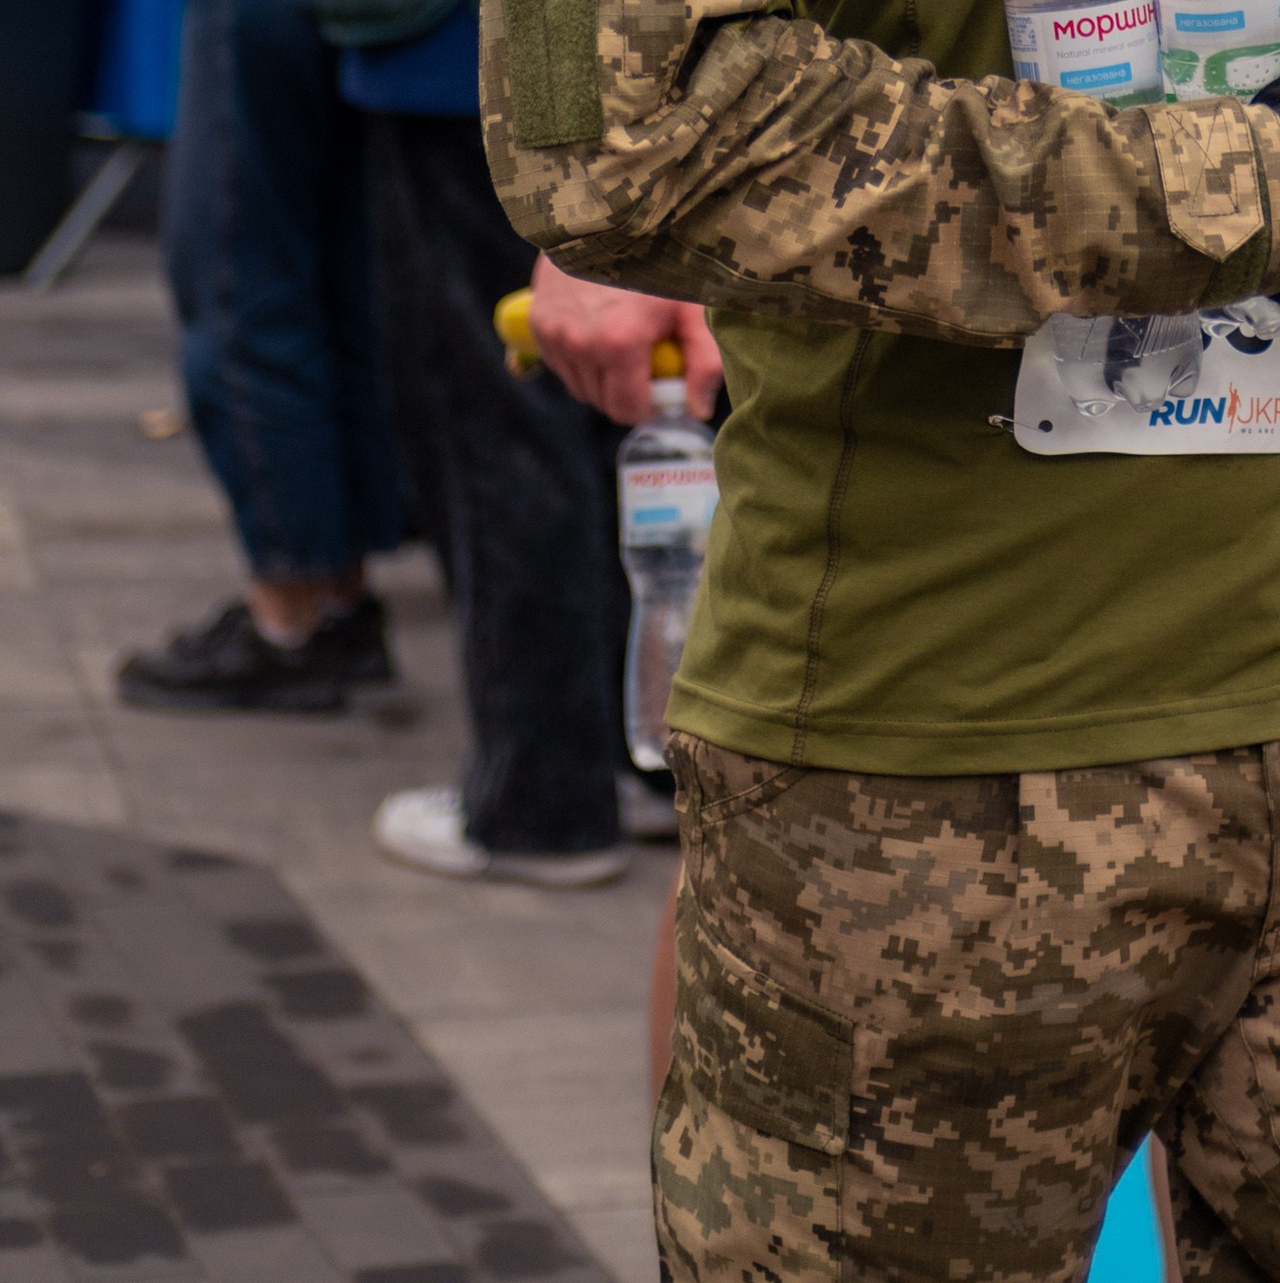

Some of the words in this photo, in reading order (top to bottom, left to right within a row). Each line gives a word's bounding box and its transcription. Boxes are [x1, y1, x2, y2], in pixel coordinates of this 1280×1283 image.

[1179, 18, 1239, 28] негазована
[1056, 48, 1091, 60] Natural
[1093, 43, 1125, 54] mineral
[1127, 38, 1146, 49] water
[1066, 69, 1127, 85] негазована
[1149, 397, 1227, 427] RUN
